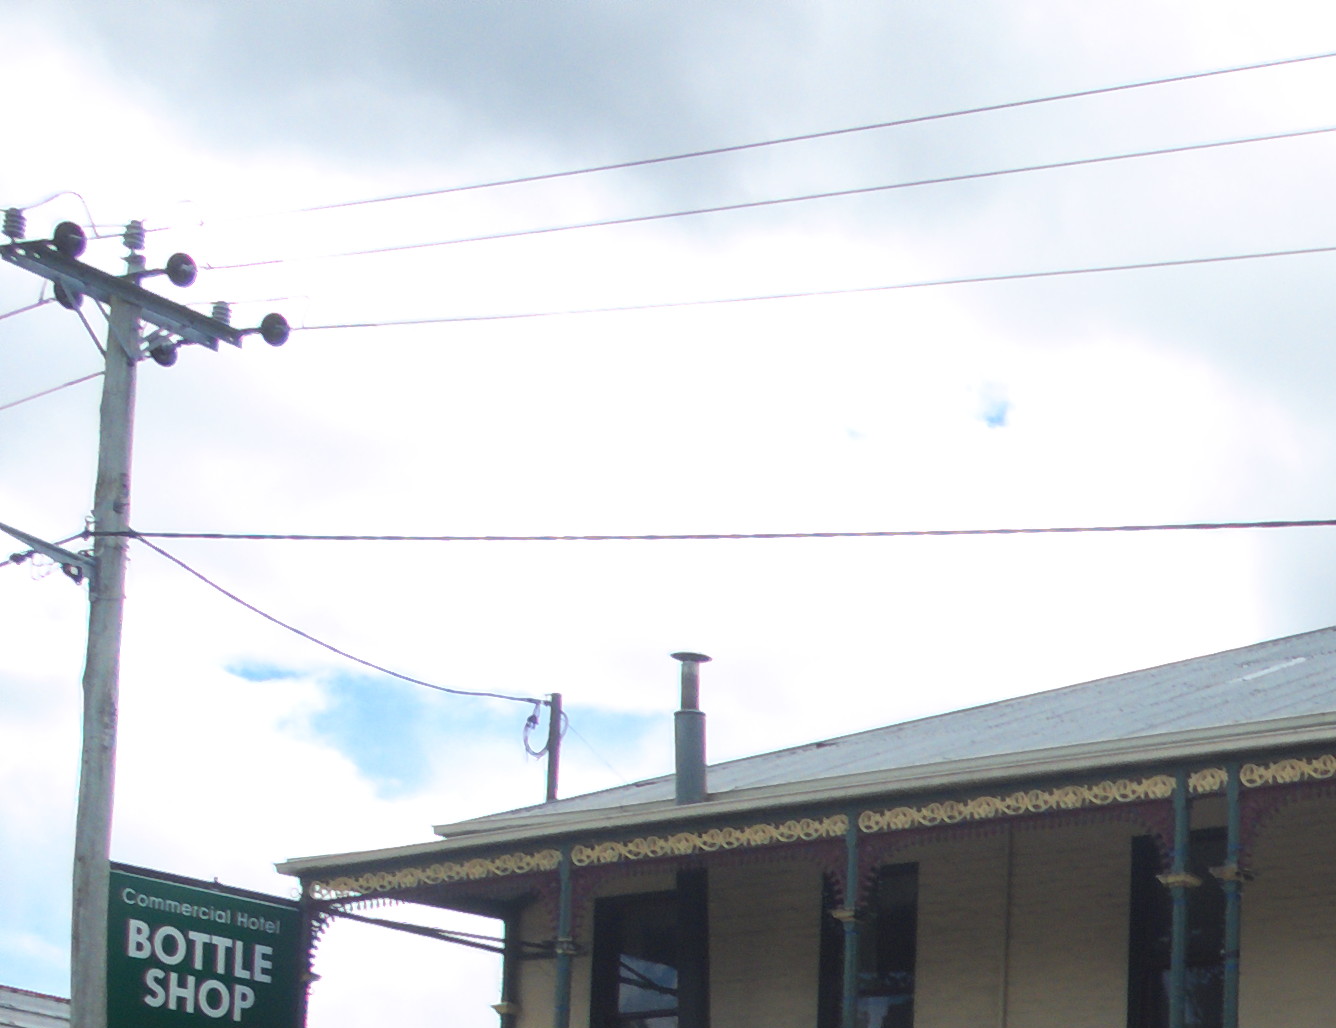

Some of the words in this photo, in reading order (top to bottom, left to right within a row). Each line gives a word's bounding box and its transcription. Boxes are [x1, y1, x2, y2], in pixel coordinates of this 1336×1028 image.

[122, 887, 231, 923] Commercial
[236, 912, 281, 934] Hotel
[128, 918, 273, 983] BOTTLE
[144, 968, 255, 1022] SHOP
